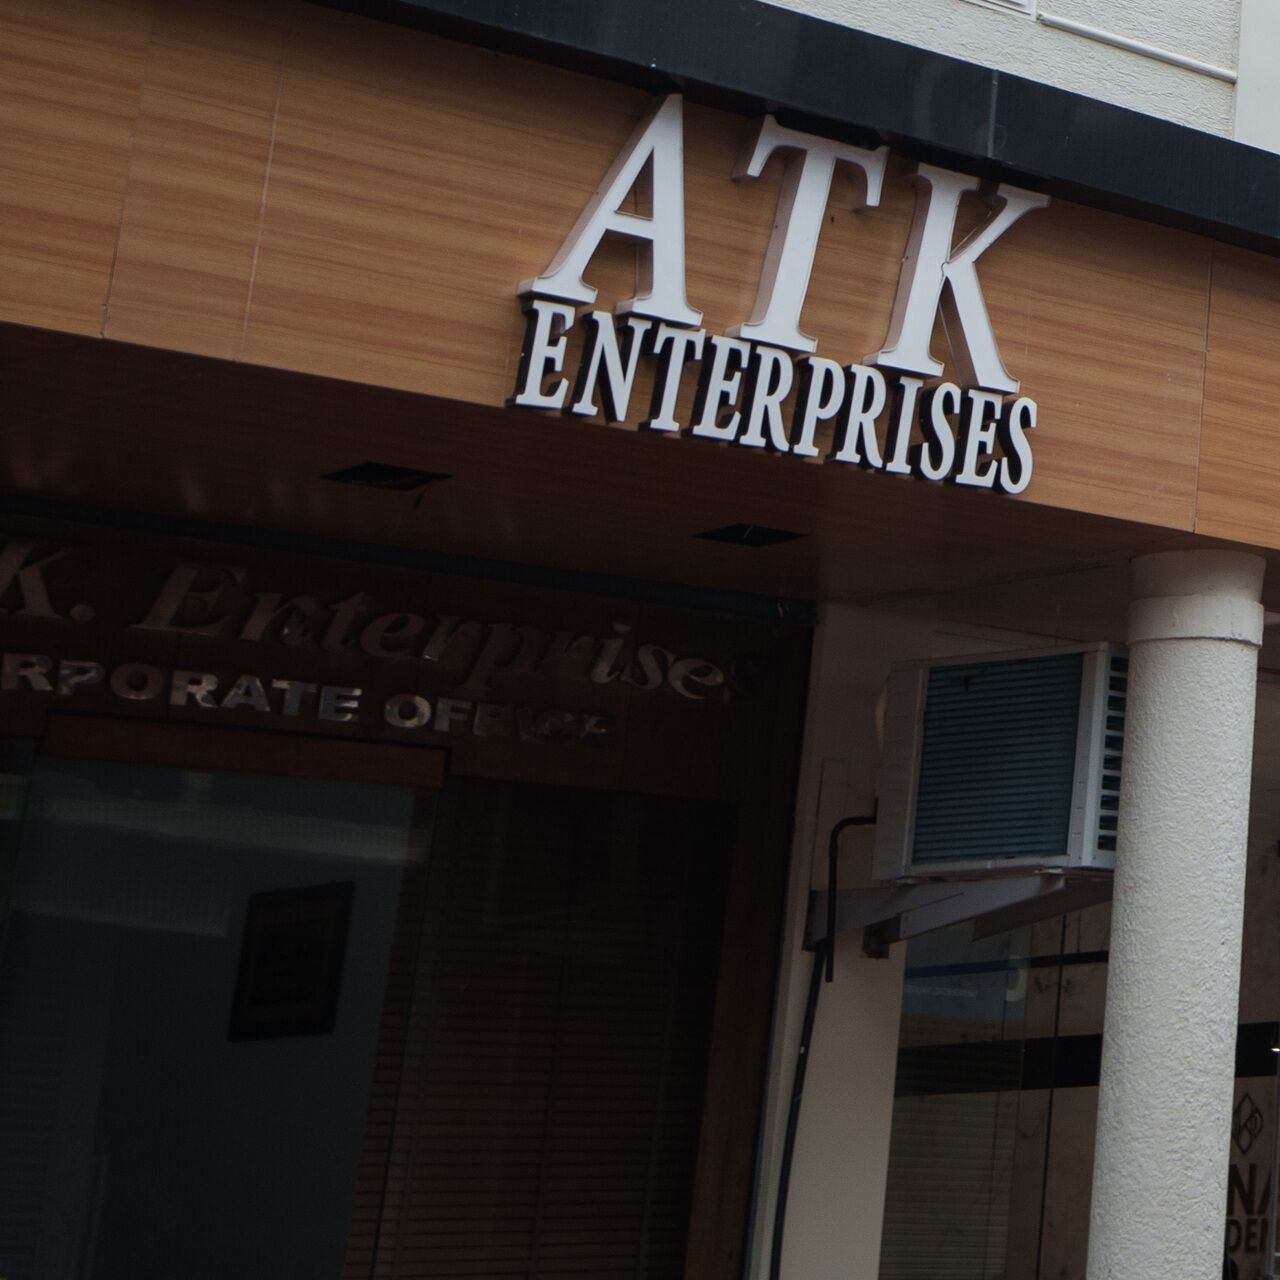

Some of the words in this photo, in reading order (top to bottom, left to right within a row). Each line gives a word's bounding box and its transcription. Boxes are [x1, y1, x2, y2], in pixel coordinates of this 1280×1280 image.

[520, 93, 1052, 394] ATK
[514, 300, 1038, 495] ENTERPRISES
[1, 651, 364, 724] RPORATE
